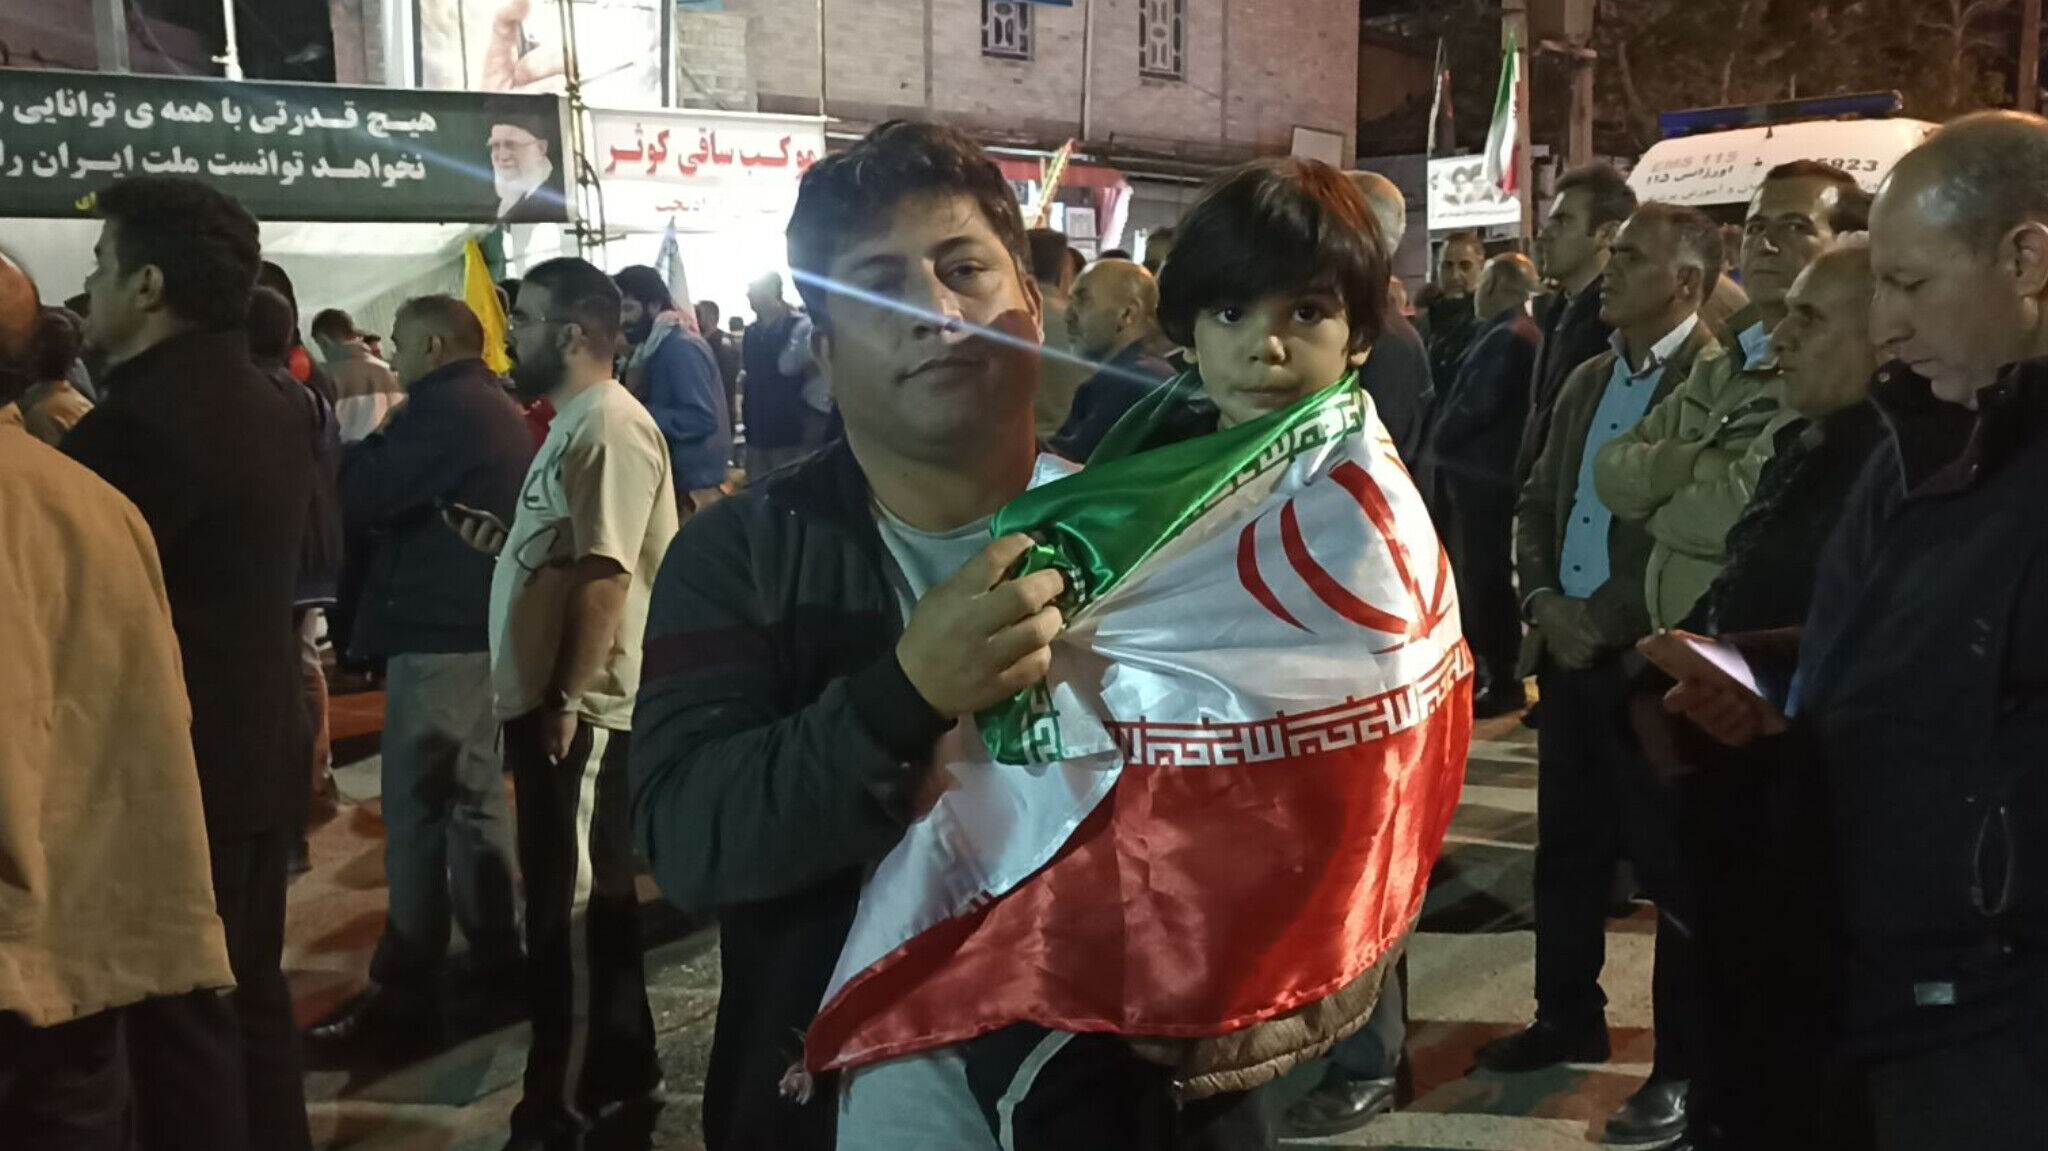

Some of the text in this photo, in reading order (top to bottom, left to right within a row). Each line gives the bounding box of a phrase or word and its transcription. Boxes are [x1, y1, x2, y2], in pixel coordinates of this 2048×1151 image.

[13, 88, 437, 138] هیچ قدرتی با همه ی توانایی
[32, 141, 134, 179] ایران
[142, 146, 200, 174] ملت
[207, 149, 304, 185] توانست
[605, 122, 670, 175] کوثر
[678, 127, 734, 175] ساقی
[1652, 150, 1739, 172] EMS 115
[311, 152, 426, 187] نخواهد
